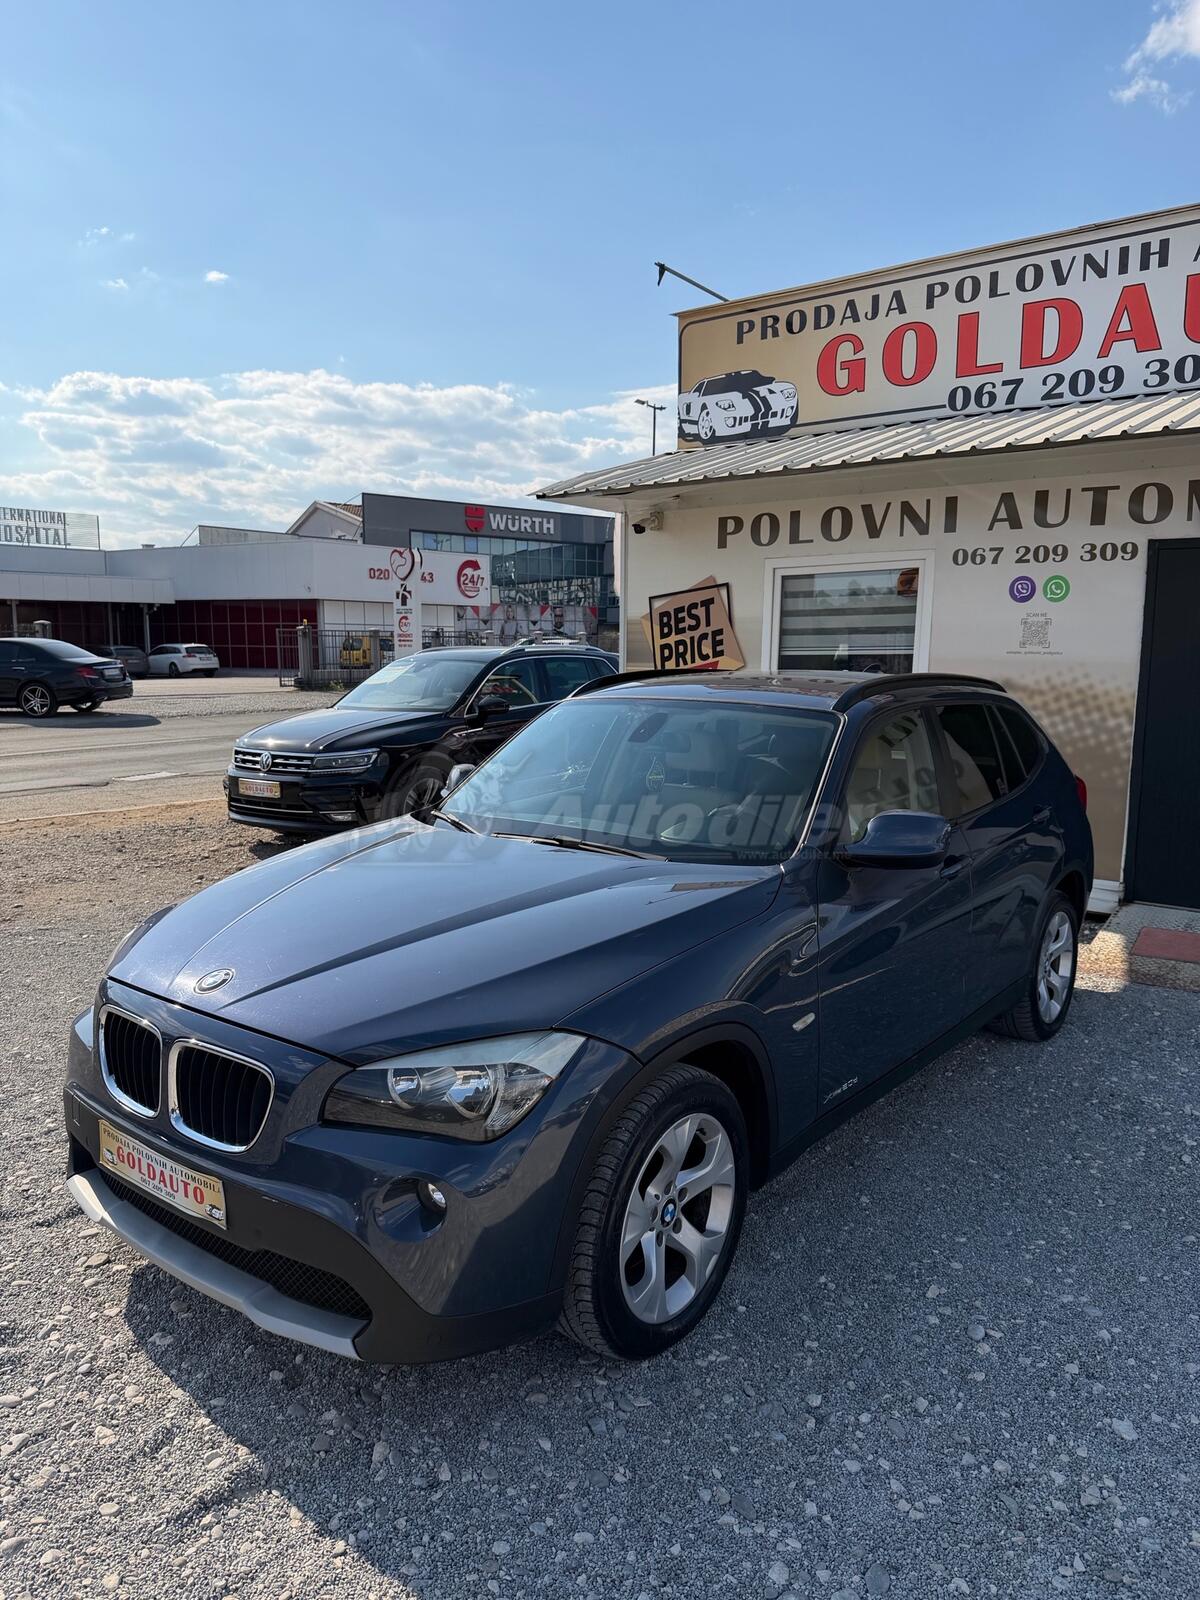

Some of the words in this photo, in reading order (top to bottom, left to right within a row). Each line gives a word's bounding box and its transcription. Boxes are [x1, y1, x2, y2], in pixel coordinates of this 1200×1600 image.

[736, 289, 907, 345] PRODAJA
[926, 237, 1170, 310] POLOVNIH
[947, 377, 1024, 413] 067
[1040, 364, 1126, 402] 209
[0, 506, 69, 526] ERNATIONAL
[717, 495, 959, 550] POLOVNI
[987, 478, 1200, 532] AUTO
[0, 524, 71, 547] OSPITAL
[952, 546, 1004, 566] 067
[1014, 543, 1069, 564] 209
[1080, 541, 1139, 562] 309
[368, 567, 390, 580] 020
[461, 573, 485, 587] 24/7
[658, 596, 715, 640] BEST
[659, 628, 725, 670] PRICE
[102, 1127, 131, 1151] PRODAJA
[131, 1144, 167, 1170] POLOVNIH
[116, 1145, 205, 1205] GOLDAUTO
